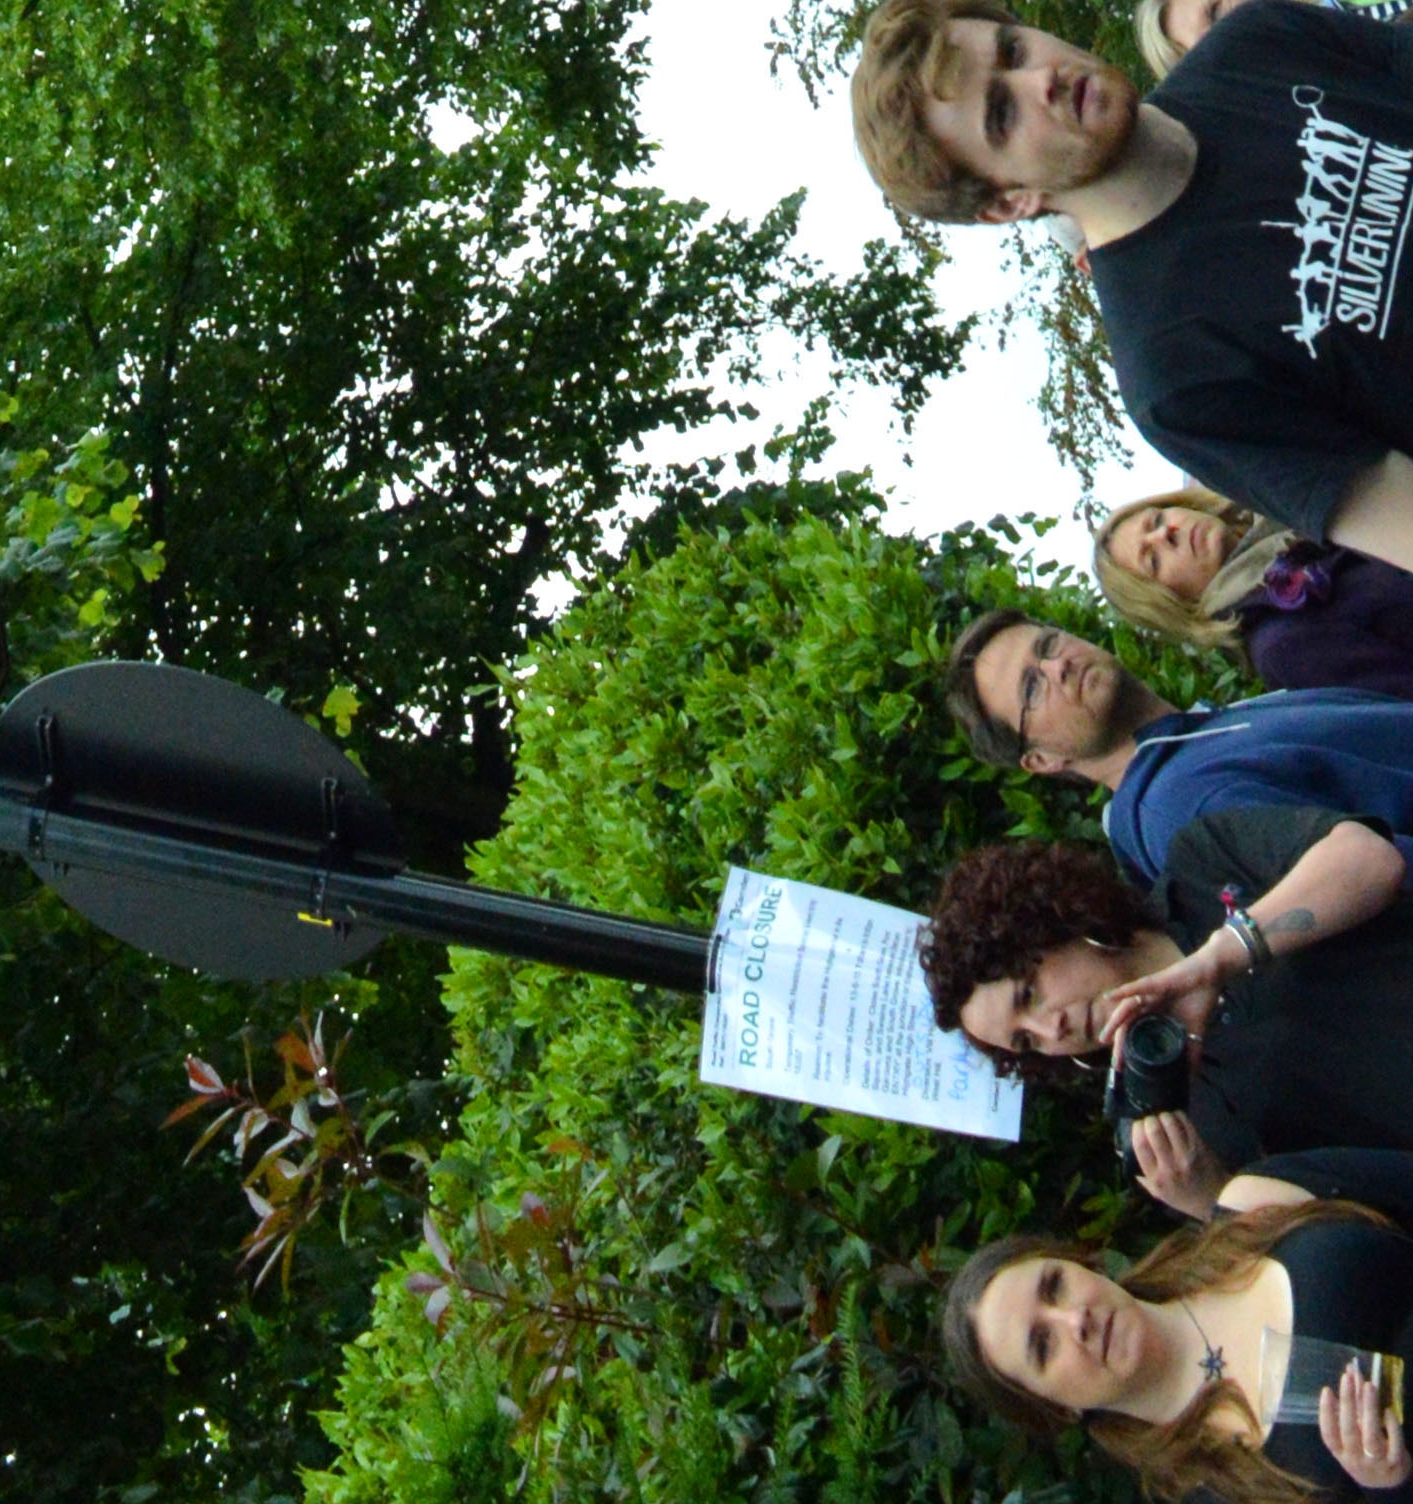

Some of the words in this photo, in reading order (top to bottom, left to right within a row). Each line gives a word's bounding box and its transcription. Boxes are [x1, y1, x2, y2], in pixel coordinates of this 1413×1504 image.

[1336, 224, 1394, 333] SILVER
[744, 885, 783, 982] CLOSURE
[739, 990, 760, 1067] ROAD
